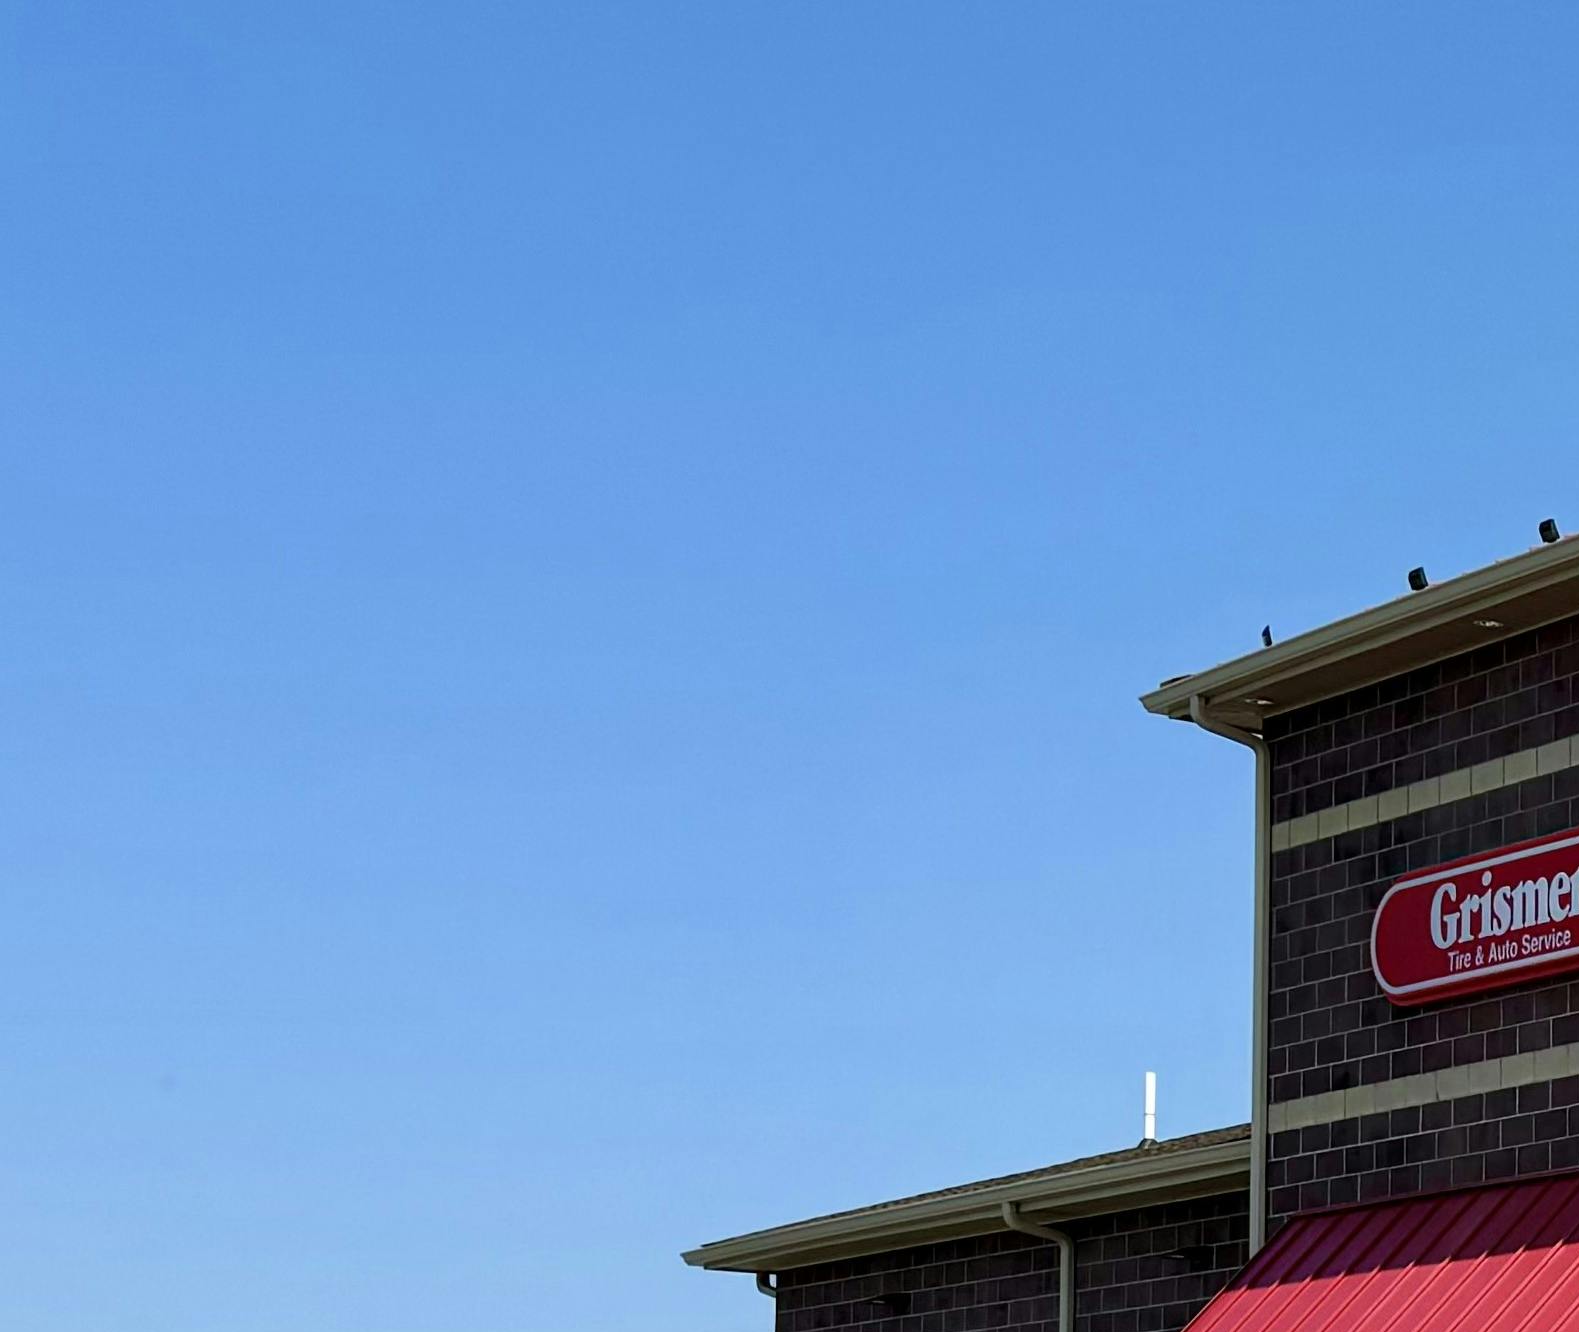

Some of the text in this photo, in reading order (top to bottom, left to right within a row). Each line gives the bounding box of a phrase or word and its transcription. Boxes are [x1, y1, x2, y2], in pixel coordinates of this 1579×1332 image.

[1447, 929, 1571, 973] Tire & Auto Service
